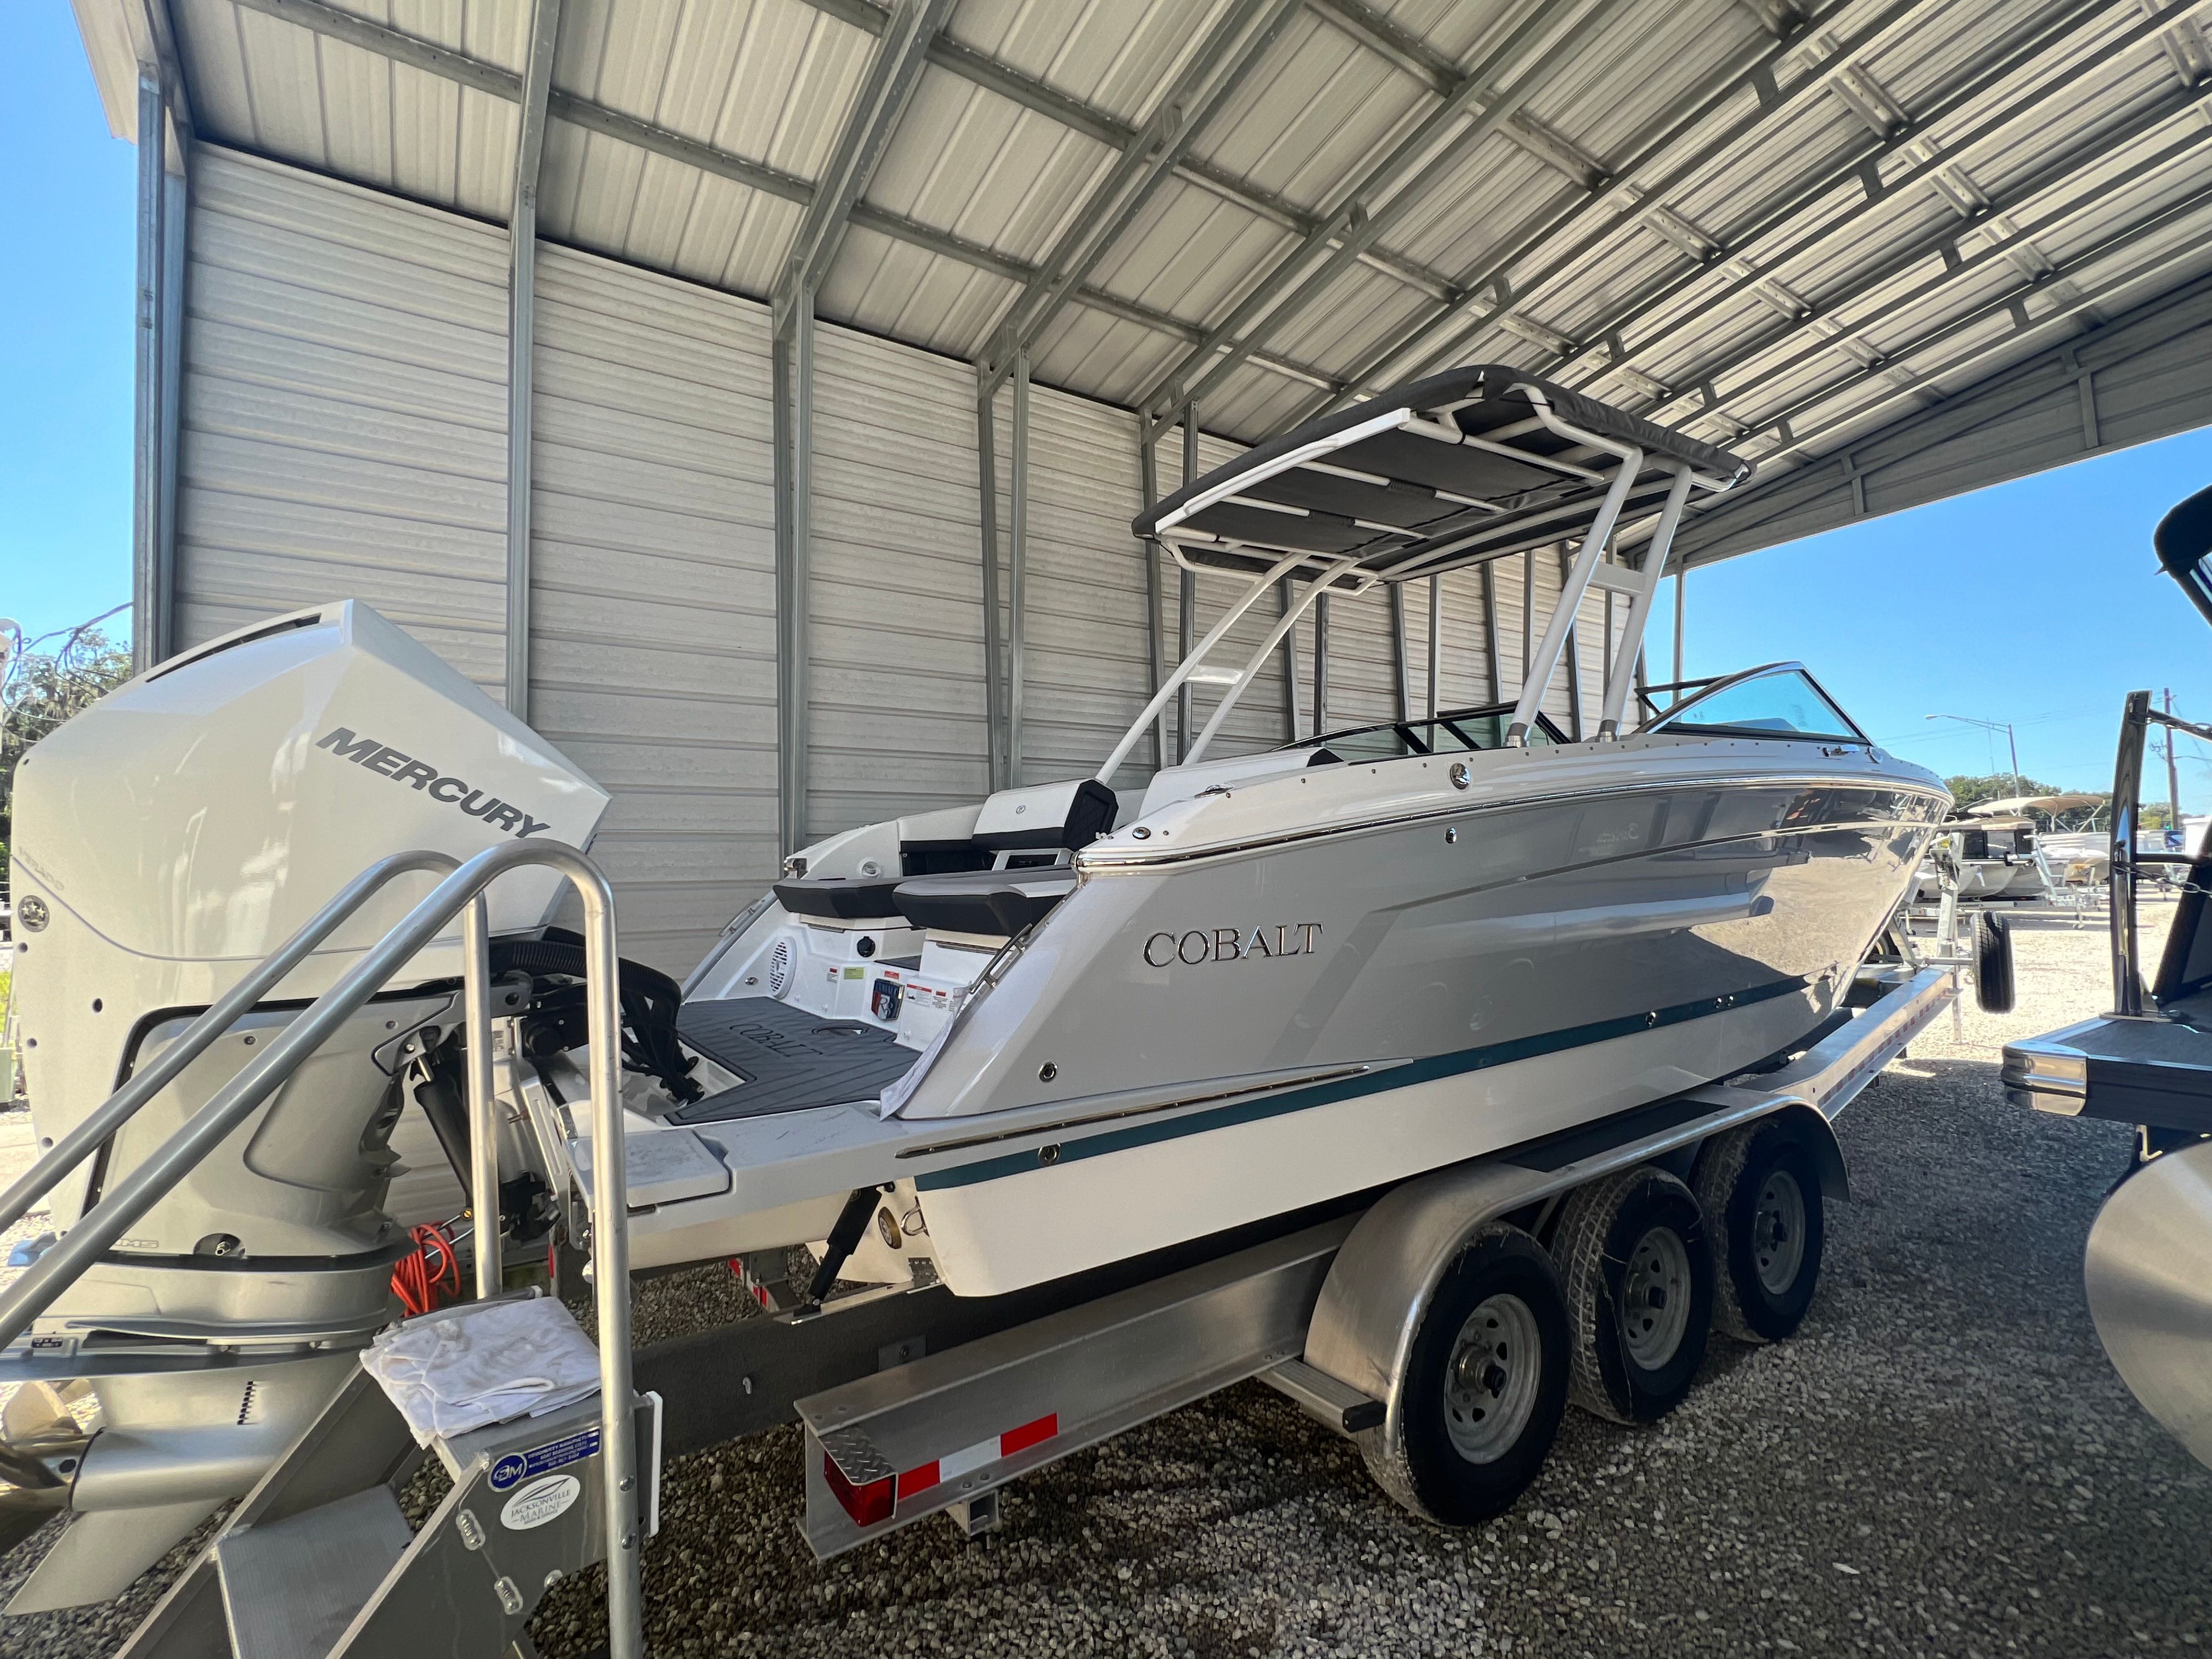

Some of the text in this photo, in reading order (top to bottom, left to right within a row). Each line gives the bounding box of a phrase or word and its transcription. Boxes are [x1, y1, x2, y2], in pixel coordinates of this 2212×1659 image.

[315, 727, 551, 838] MERCURY
[18, 846, 64, 891] VERADO
[1143, 922, 1323, 967] COBALT
[729, 1024, 823, 1057] COBALT
[511, 1489, 571, 1518] JACKSONVILLE
[520, 1501, 561, 1522] MARINE
